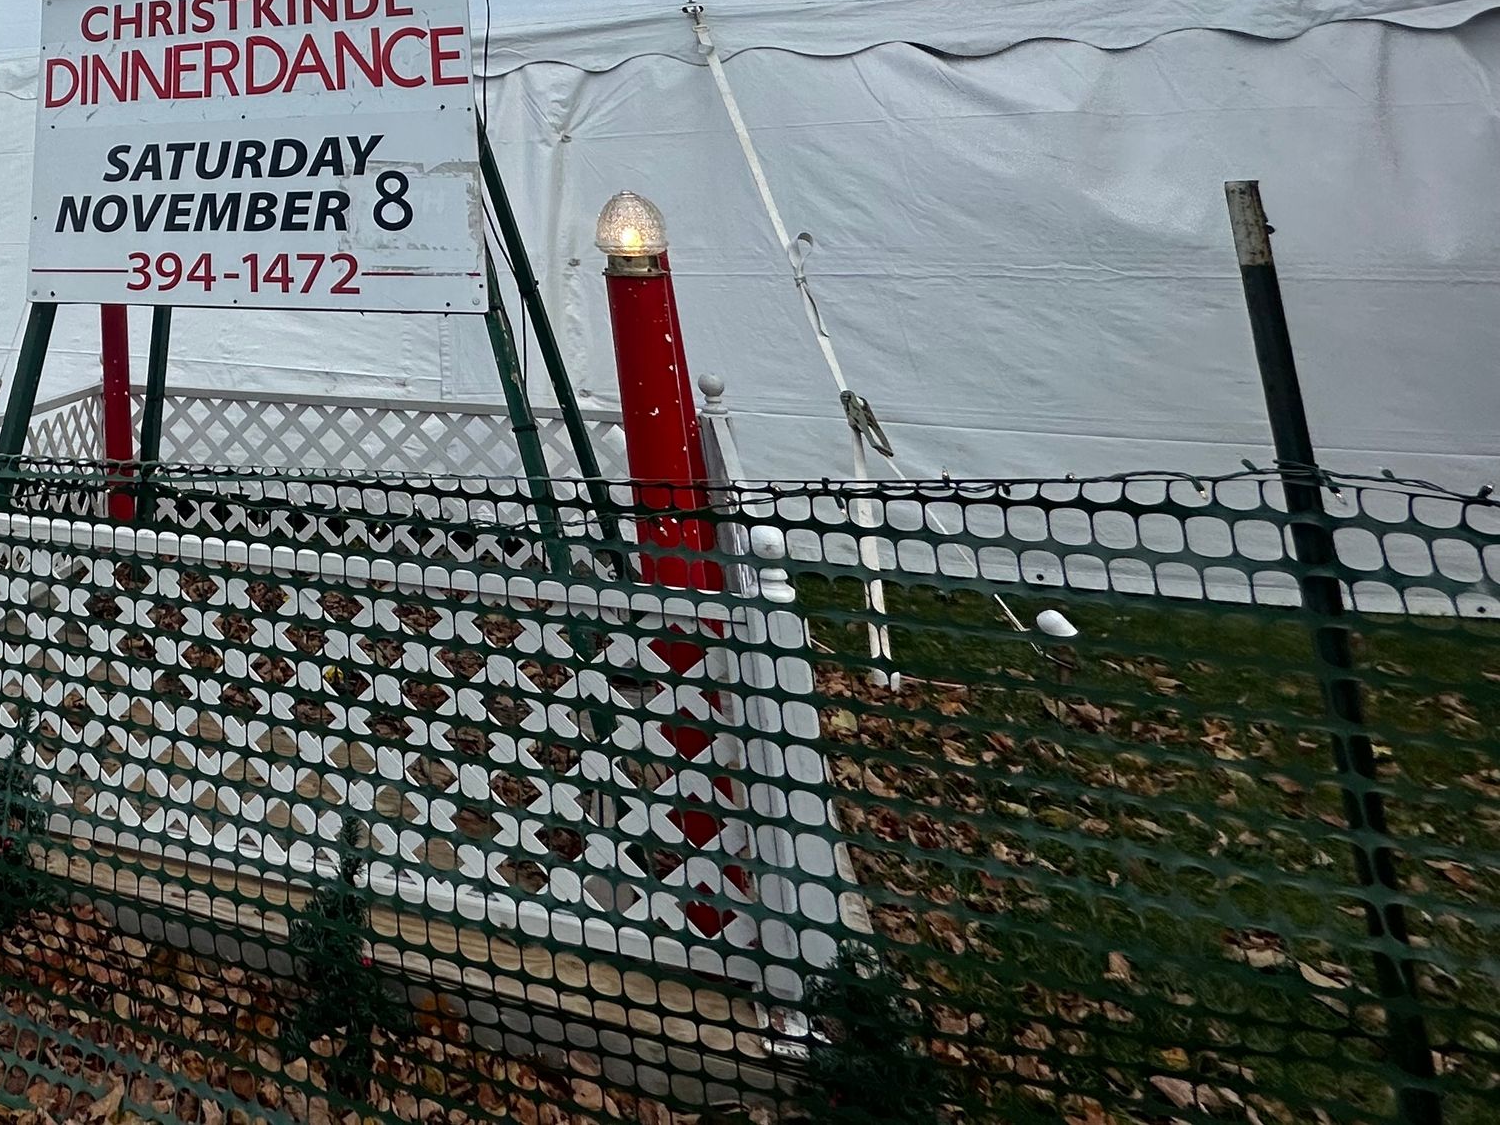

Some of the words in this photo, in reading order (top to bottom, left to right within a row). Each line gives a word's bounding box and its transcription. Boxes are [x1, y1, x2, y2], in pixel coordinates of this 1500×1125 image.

[103, 135, 384, 181] SATURDAY
[55, 190, 351, 232] NOVEMBER
[373, 171, 413, 231] 8
[126, 252, 360, 294] 394-1472
